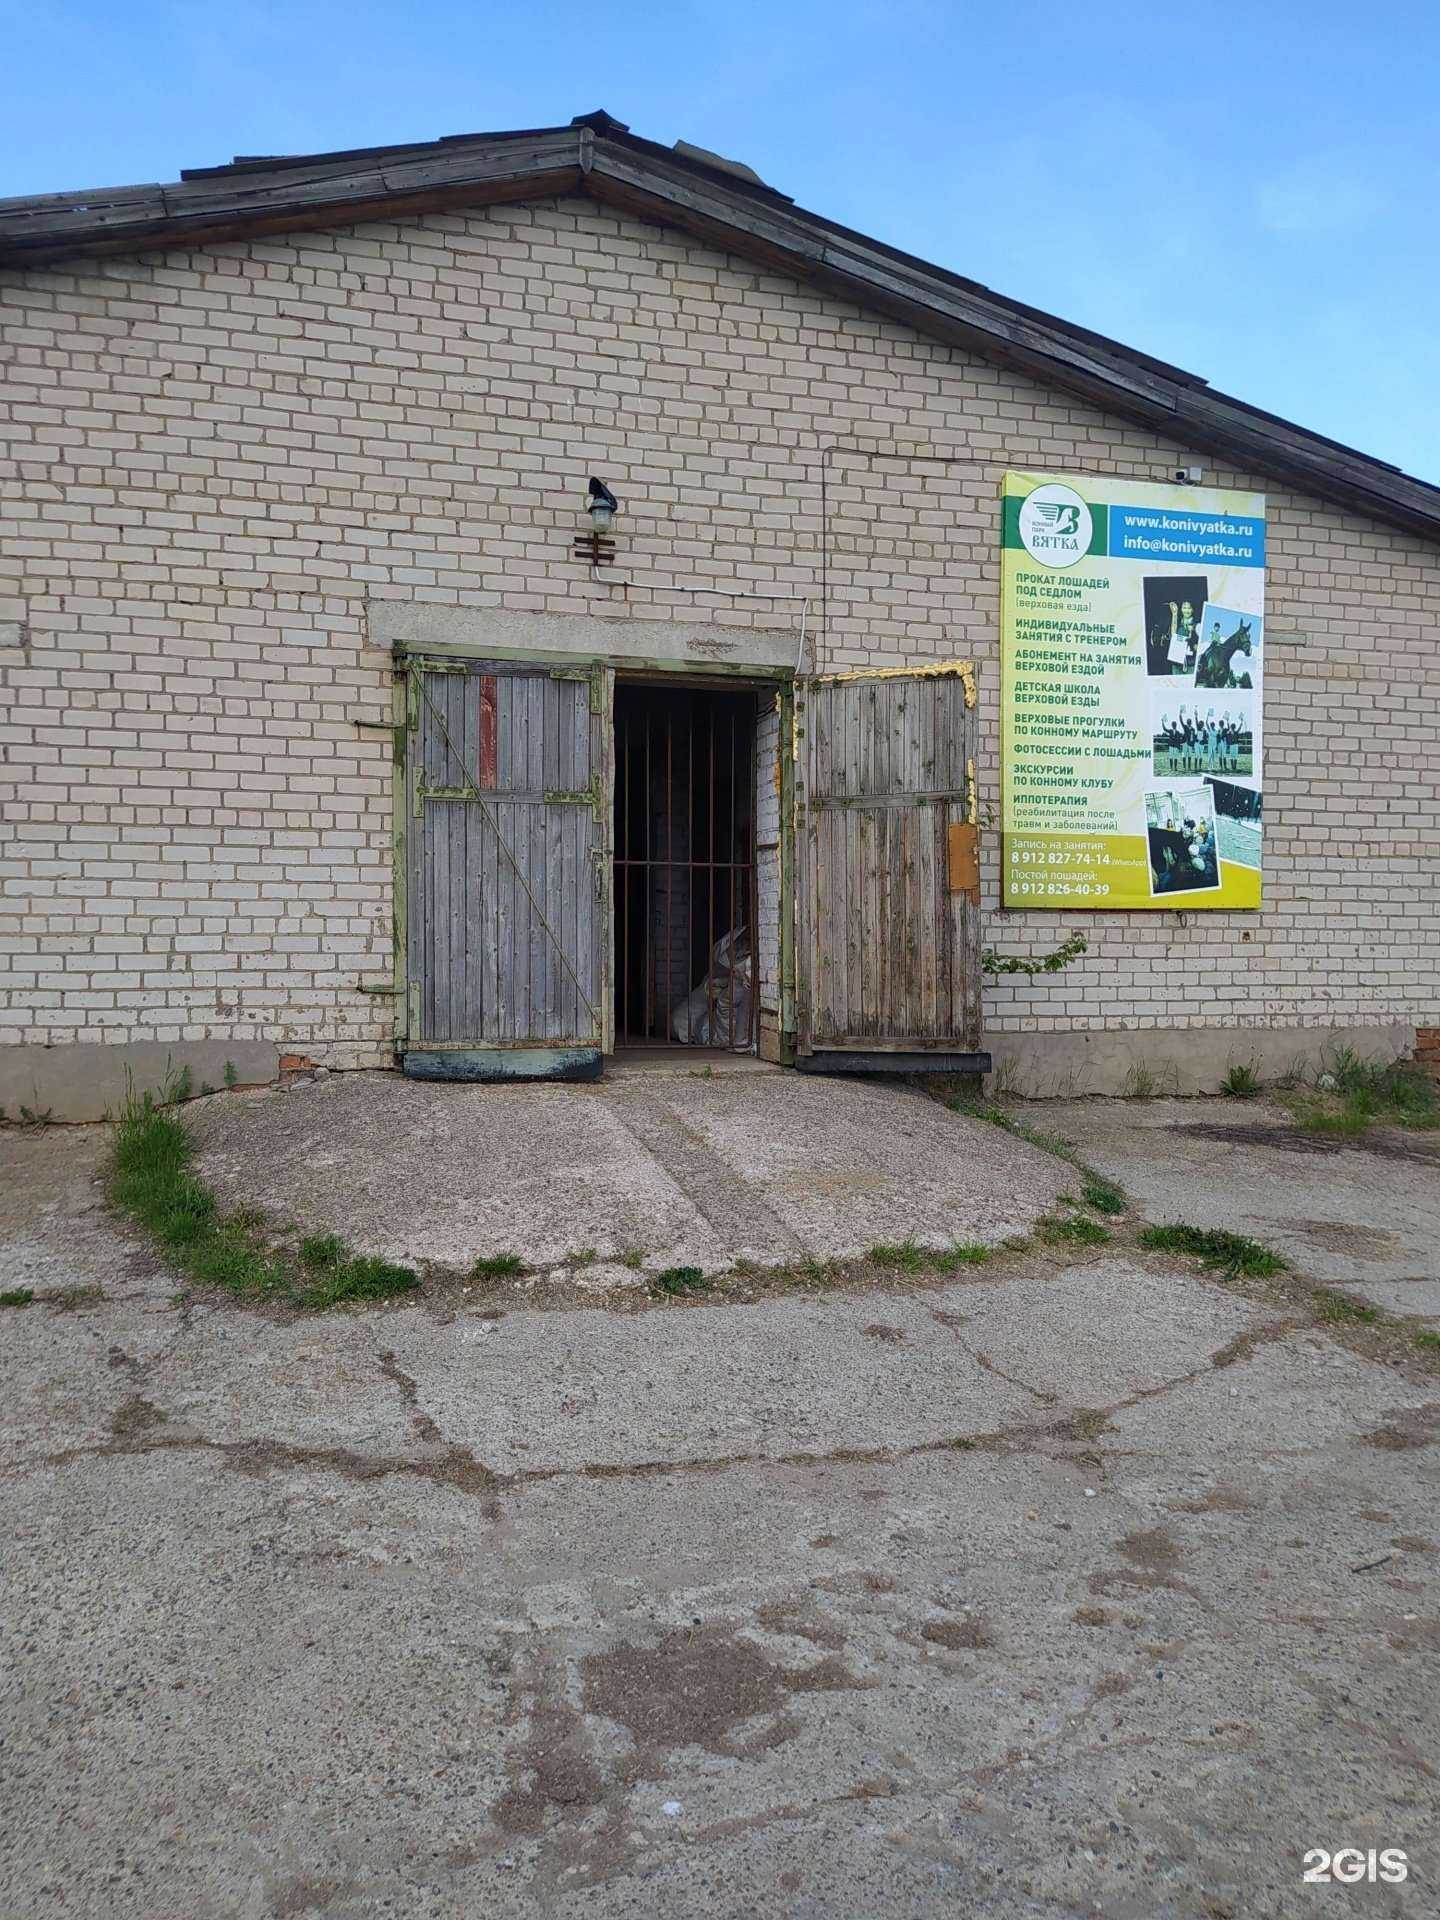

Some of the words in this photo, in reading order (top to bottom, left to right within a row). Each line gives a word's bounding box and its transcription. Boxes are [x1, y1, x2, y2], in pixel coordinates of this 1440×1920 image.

[1124, 515, 1253, 537] www.konivyatka.ru
[1032, 534, 1080, 551] ВЯТКА
[1123, 536, 1253, 558] info@konivyatka.ru
[1016, 573, 1056, 585] ПРОКАТ
[1057, 576, 1110, 590] ЛОШАДЕЙ
[1016, 585, 1037, 597] ПОД
[1039, 587, 1082, 599] СЕДЛОМ
[1016, 598, 1064, 611] (верховая
[1066, 602, 1092, 612] езда)
[1016, 618, 1115, 634] ИНДИВИДУАЛЬНЫЕ
[1015, 631, 1063, 642] ЗАНЯТИЯ
[1065, 634, 1072, 643] С
[1074, 634, 1127, 646] ТРЕНЕРОМ
[1015, 649, 1077, 662] АБОНЕМЕНТ
[1079, 653, 1093, 663] НА
[1095, 653, 1142, 665] ЗАНЯТИЯ
[1015, 661, 1069, 673] ВЕРХОВОЙ
[1071, 664, 1105, 675] ЕЗДОЙ
[1014, 681, 1062, 692] ДЕТСКАЯ
[1064, 684, 1101, 695] ШКОЛА
[1014, 693, 1069, 705] ВЕРХОВОЙ
[1071, 697, 1100, 707] ЕЗДЫ
[1014, 713, 1070, 725] ВЕРХОВЫЕ
[1072, 716, 1125, 728] ПРОГУЛКИ
[1014, 725, 1028, 735] ПО
[1030, 727, 1082, 738] КОННОМУ
[1082, 729, 1138, 740] МАРШРУТУ
[1014, 744, 1082, 757] ФОТОСЕССИИ
[1084, 747, 1092, 757] С
[1093, 748, 1152, 760] ЛОШАДЬМИ
[1013, 764, 1074, 775] ЭКСКУРСИИ
[1013, 776, 1027, 786] ПО
[1030, 777, 1079, 788] КОННОМУ
[1081, 779, 1114, 789] КЛУБУ
[1013, 794, 1088, 806] ИППОТЕРАПИЯ
[1013, 807, 1085, 820] (реабилитация
[1087, 810, 1115, 819] после
[1013, 820, 1042, 830] травм
[1044, 821, 1050, 829] и
[1053, 820, 1118, 831] заболеваний)
[1011, 838, 1047, 849] Запись
[1050, 841, 1062, 849] на
[1064, 841, 1107, 850] занятия:
[1011, 852, 1019, 864] 8
[1022, 852, 1045, 864] 912
[1048, 853, 1111, 865] 827-74-14
[1011, 869, 1049, 880] Постой
[1050, 871, 1098, 882] лошадей:
[1010, 883, 1018, 894] 8
[1021, 883, 1045, 895] 912
[1047, 884, 1110, 896] 826-40-39
